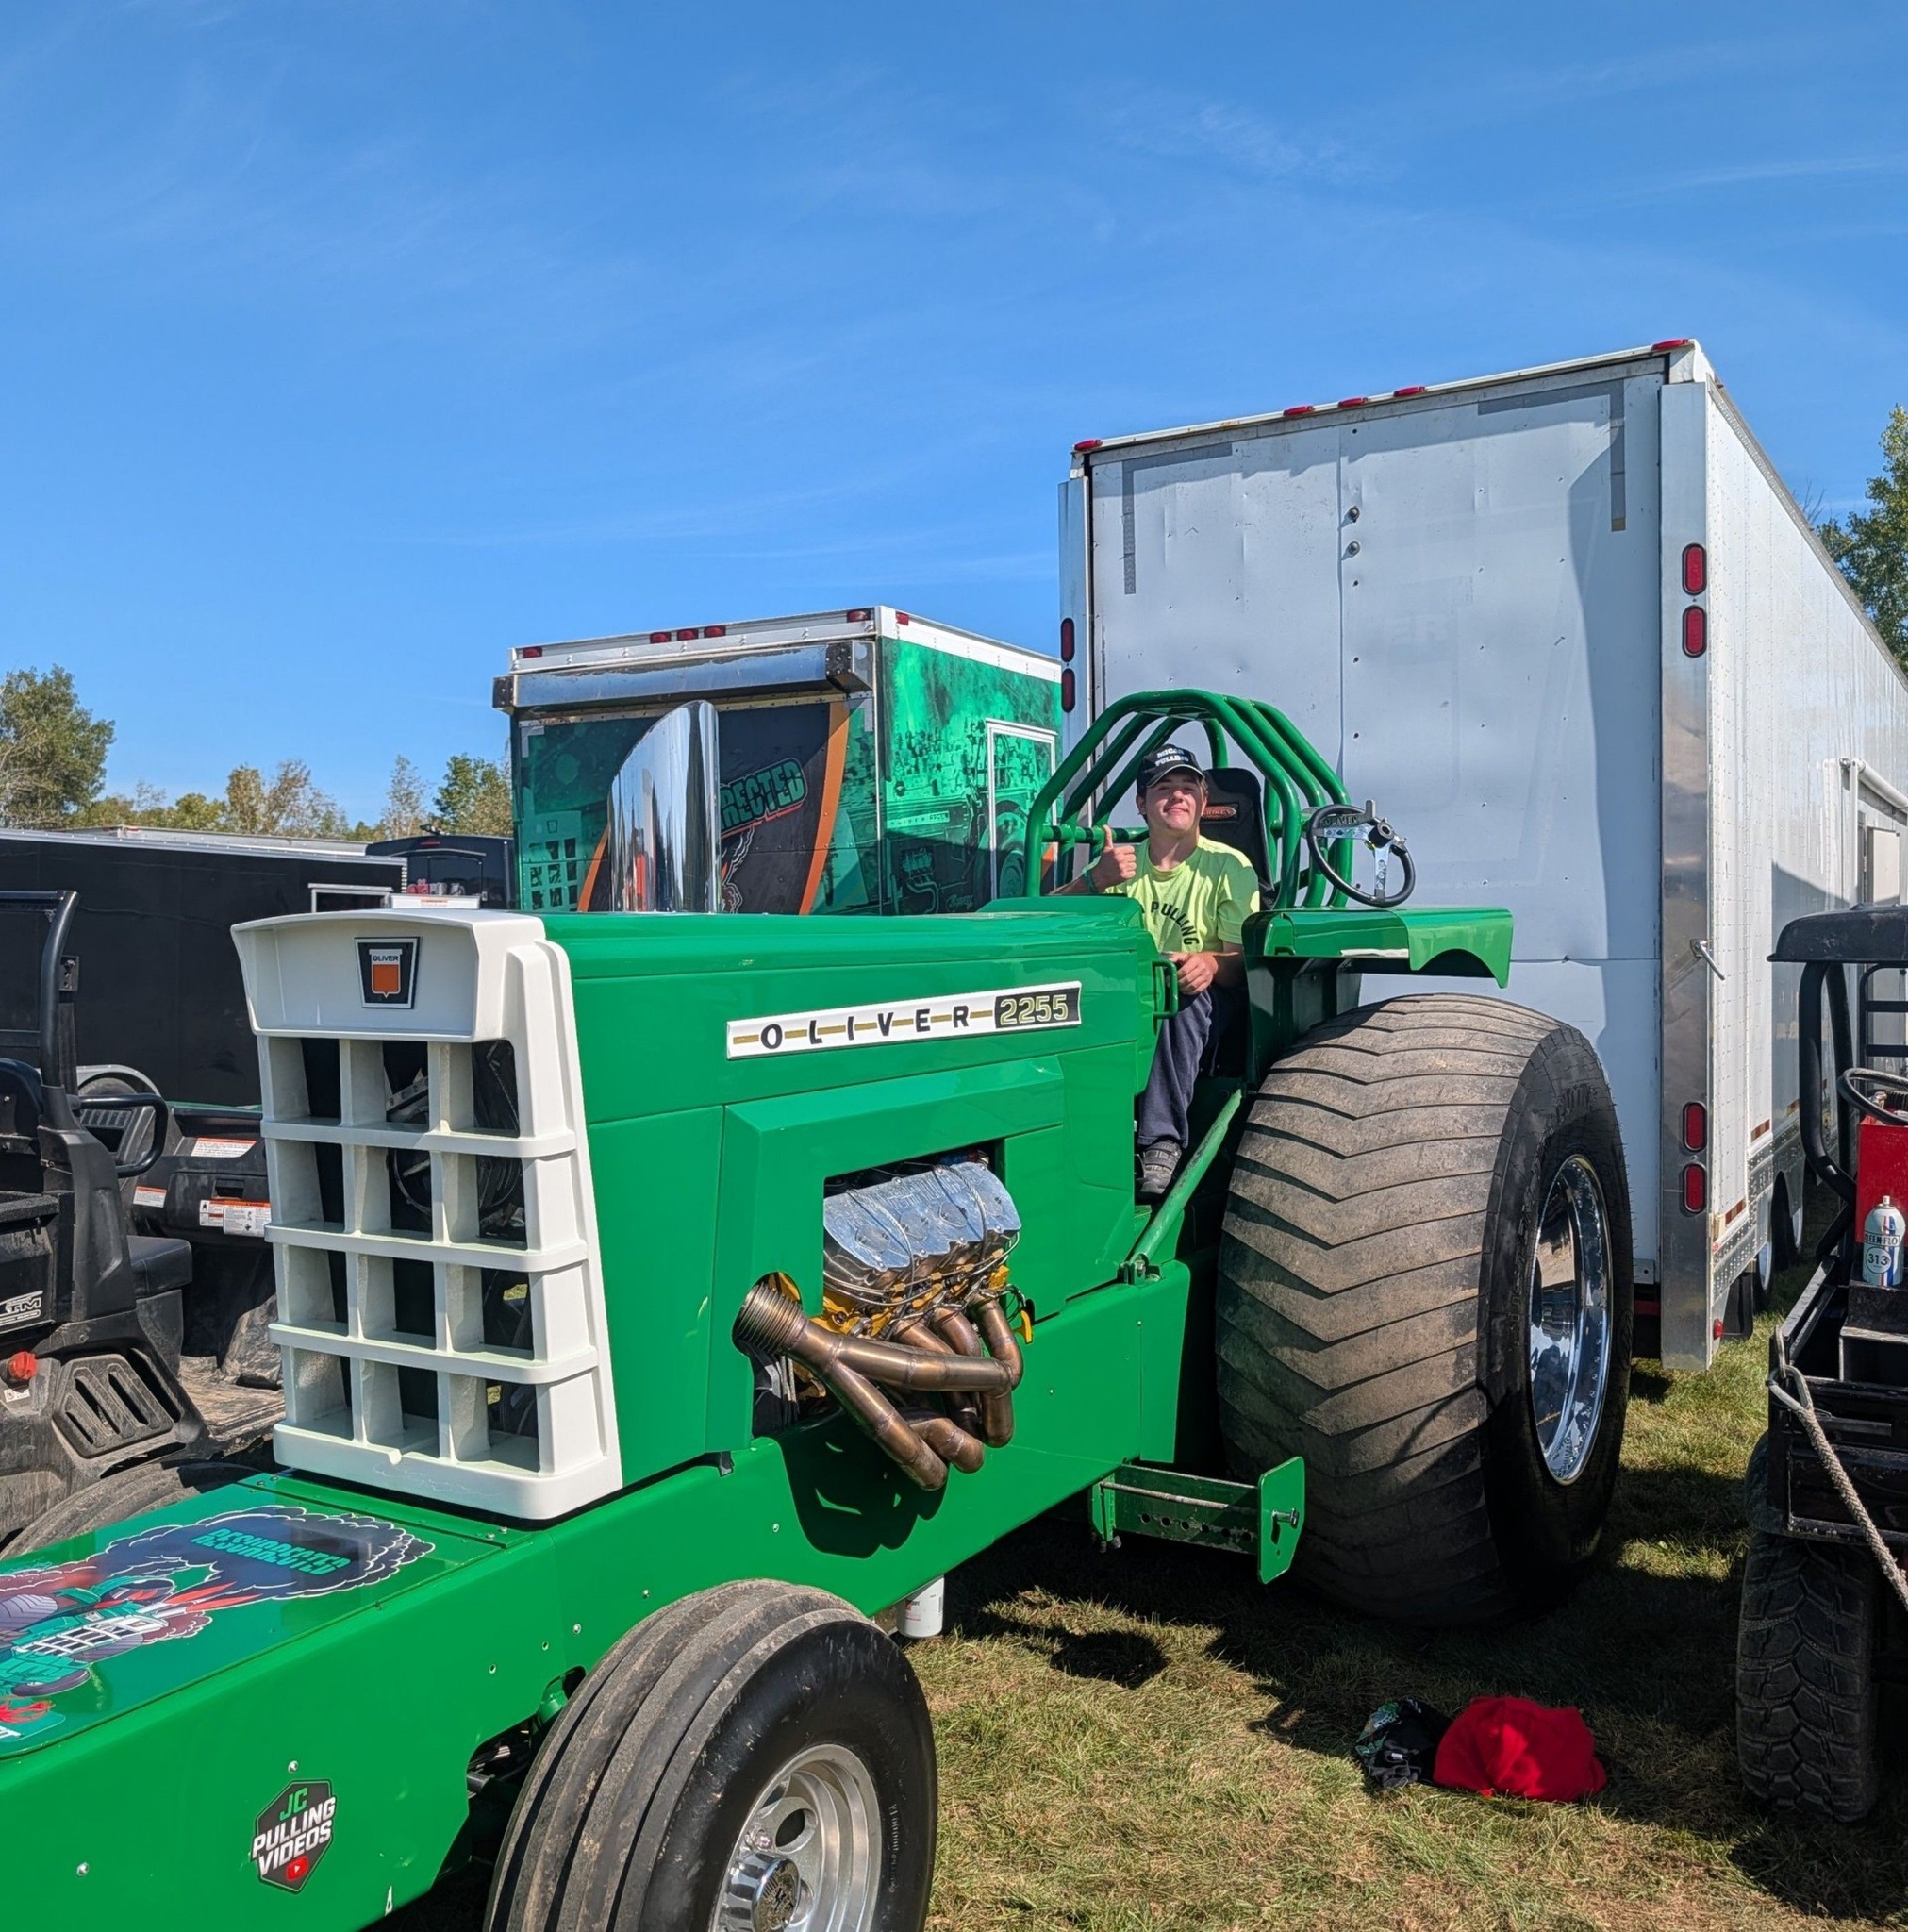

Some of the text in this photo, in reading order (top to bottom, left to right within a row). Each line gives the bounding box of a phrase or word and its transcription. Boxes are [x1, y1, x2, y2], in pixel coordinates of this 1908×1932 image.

[1151, 901, 1200, 945] PULLING
[760, 993, 1070, 1051] OLIVER 2255
[1867, 1253, 1889, 1266] 313
[190, 1527, 351, 1575] RESURRECTED
[252, 1797, 337, 1858] PULLING
[279, 1787, 308, 1821] JC
[258, 1819, 333, 1876] VIDEOS
